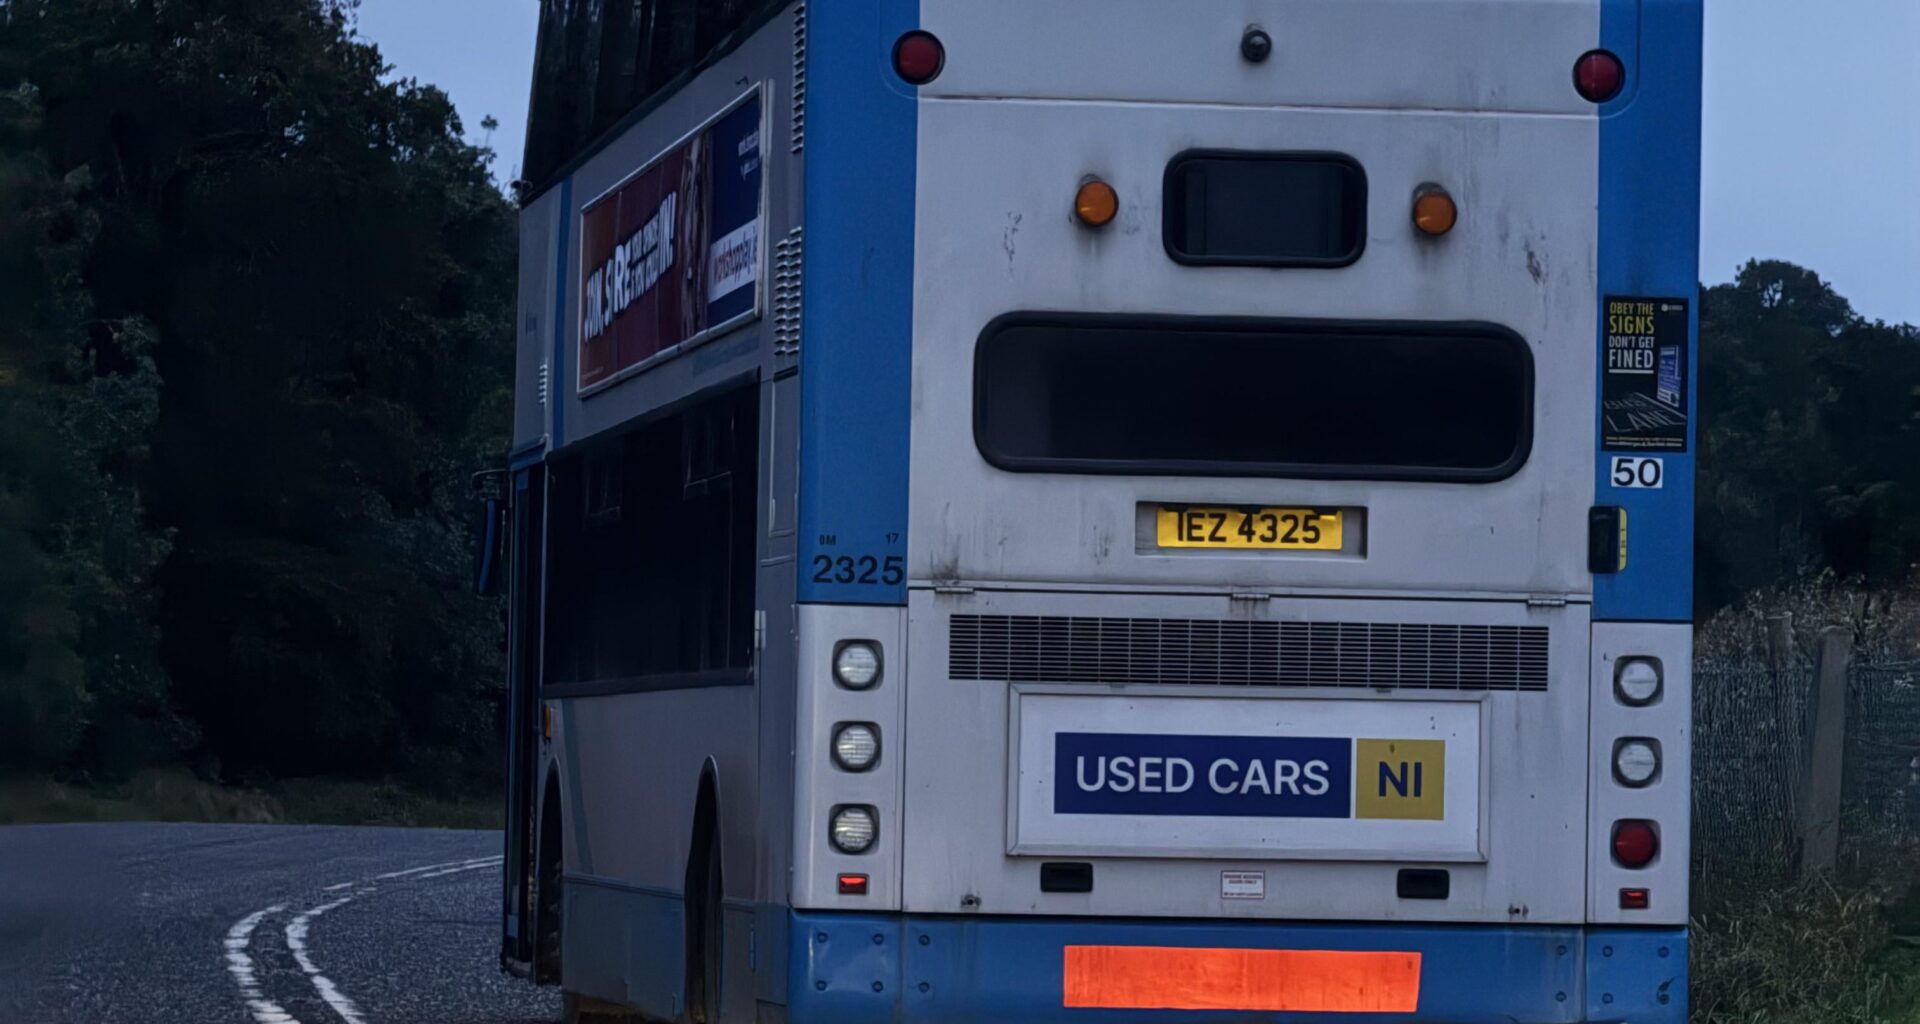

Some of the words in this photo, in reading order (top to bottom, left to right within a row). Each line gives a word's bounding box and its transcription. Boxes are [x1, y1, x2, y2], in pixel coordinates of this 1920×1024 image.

[1609, 301, 1635, 314] OBEY
[1637, 302, 1655, 315] THE
[1609, 315, 1655, 335] SIGNS
[1608, 336, 1636, 349] DON'T
[1638, 336, 1655, 350] GET
[1608, 349, 1655, 369] FINED
[1613, 458, 1661, 487] 50
[1177, 511, 1227, 543] IEZ
[1238, 511, 1321, 544] 4325
[885, 532, 900, 545] 17
[812, 554, 904, 586] 2325
[1075, 754, 1196, 794] USED
[1207, 758, 1331, 797] CARS
[1377, 760, 1423, 798] NI
